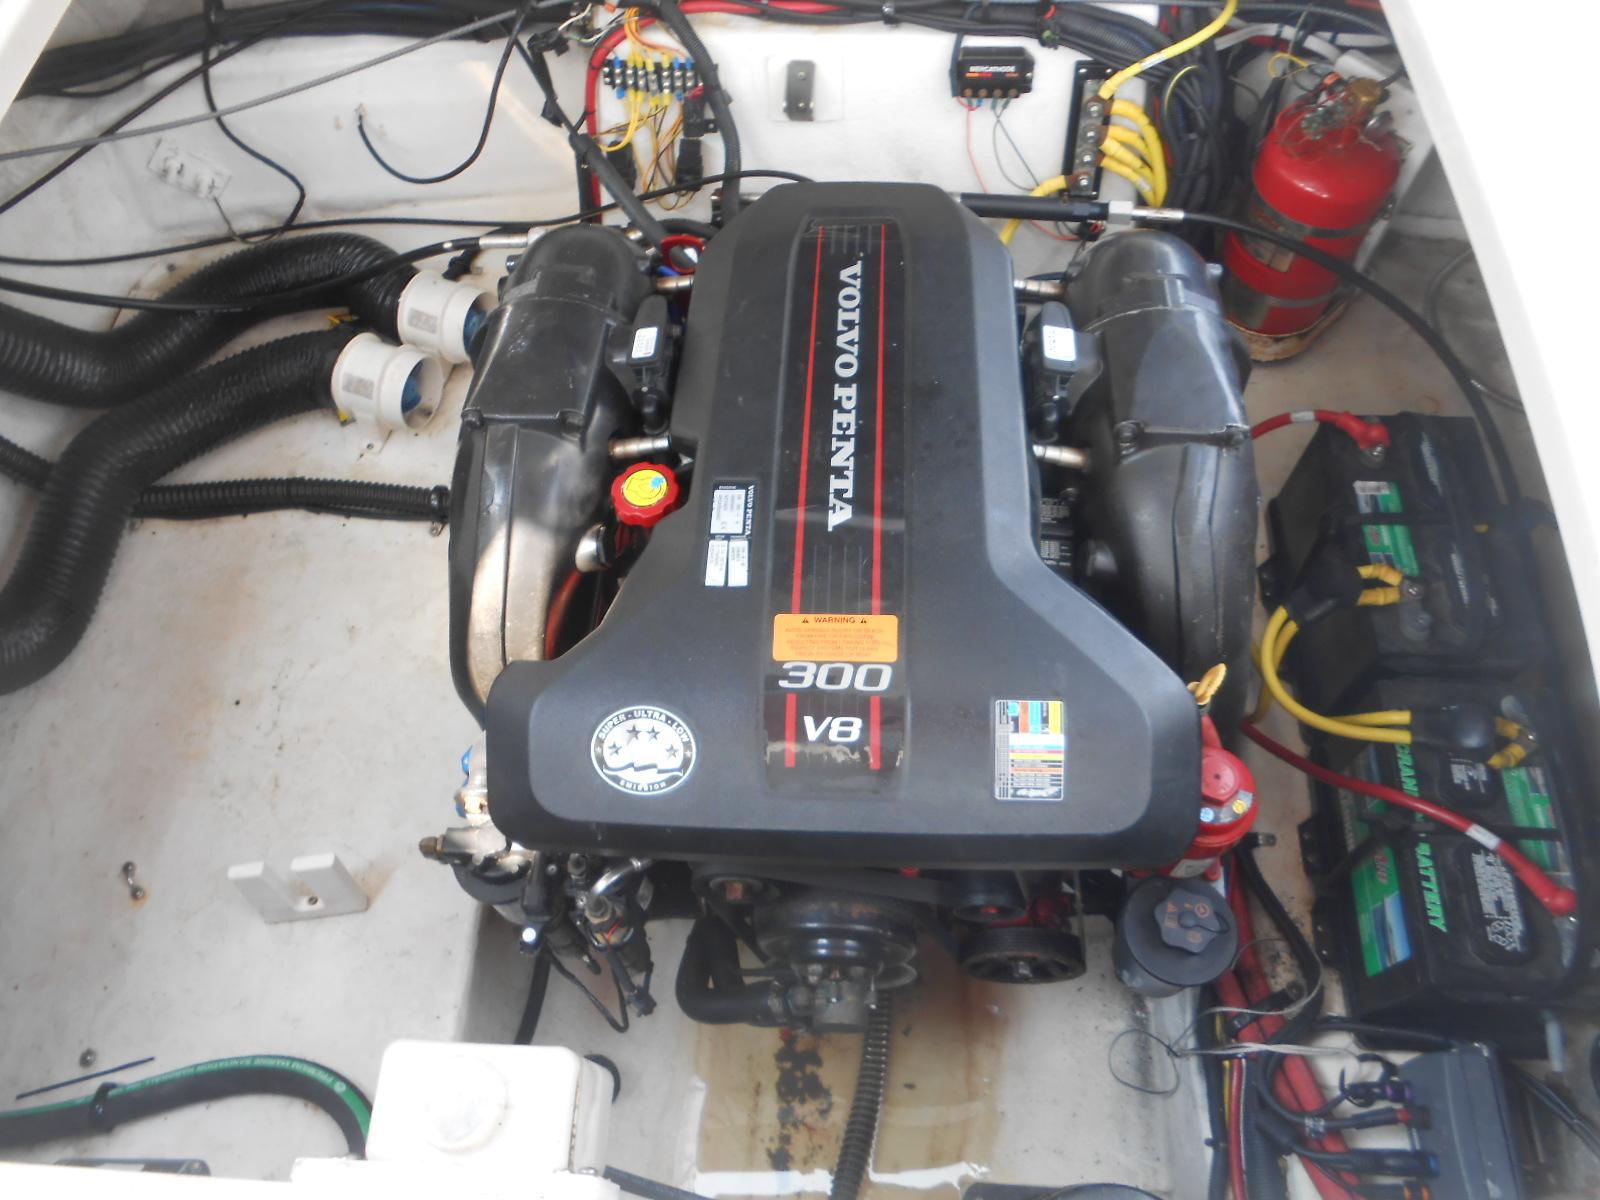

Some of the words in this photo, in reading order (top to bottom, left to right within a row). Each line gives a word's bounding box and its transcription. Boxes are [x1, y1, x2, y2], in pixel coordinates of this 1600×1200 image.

[834, 260, 862, 378] VOLVO
[828, 383, 857, 532] PENTA
[746, 485, 755, 508] VOLVO
[744, 508, 753, 536] PENTA
[814, 616, 856, 624] WARNING
[778, 661, 893, 691] 300
[598, 714, 627, 740] SUPER
[633, 710, 666, 721] ULTRA
[671, 722, 690, 743] LOW
[803, 715, 863, 742] V8
[1415, 842, 1448, 934] BATTERY
